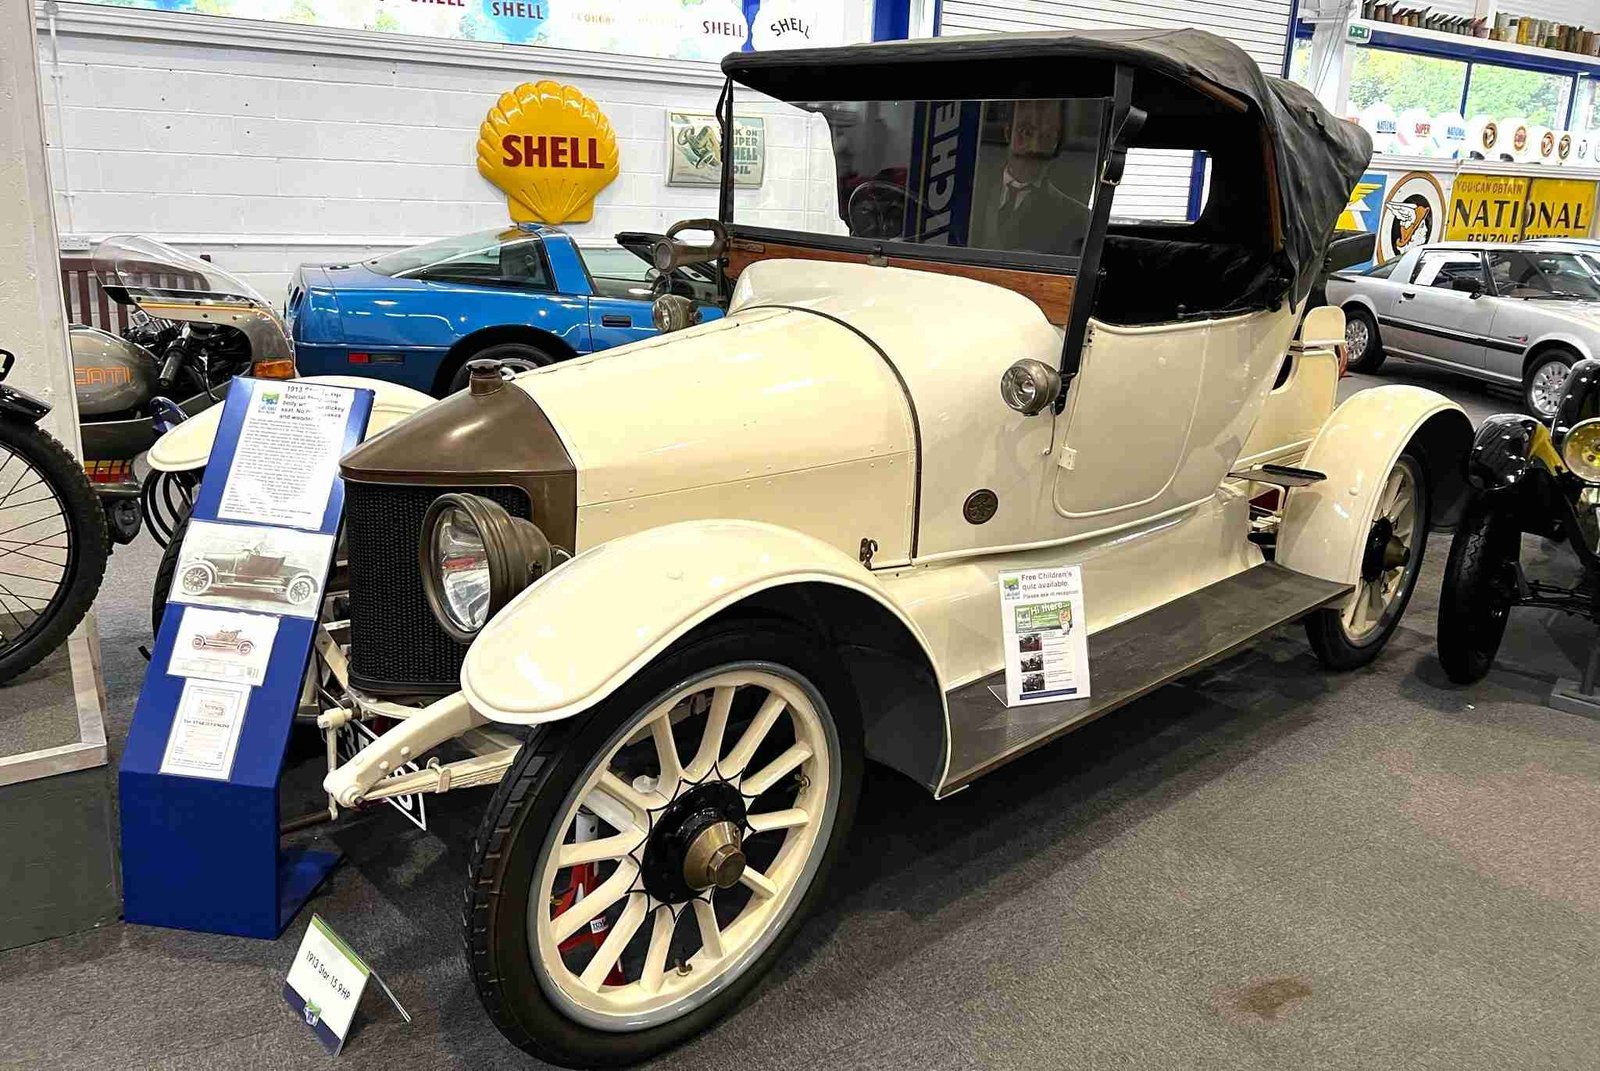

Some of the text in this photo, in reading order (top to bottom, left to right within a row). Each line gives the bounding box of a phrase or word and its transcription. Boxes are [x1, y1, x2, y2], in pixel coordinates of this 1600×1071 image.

[492, 2, 544, 20] SHELL
[702, 20, 745, 38] SHELL
[770, 17, 810, 39] SHELL
[745, 129, 758, 137] ON
[1415, 122, 1431, 135] SUPER
[502, 134, 605, 169] SHELL
[1457, 180, 1523, 195] YOU CAN OBTAIN
[75, 366, 132, 385] CATI
[287, 385, 303, 393] 1913
[1038, 571, 1072, 580] Children's
[1022, 583, 1037, 591] quiz
[306, 951, 319, 969] 1913
[318, 964, 330, 980] Star
